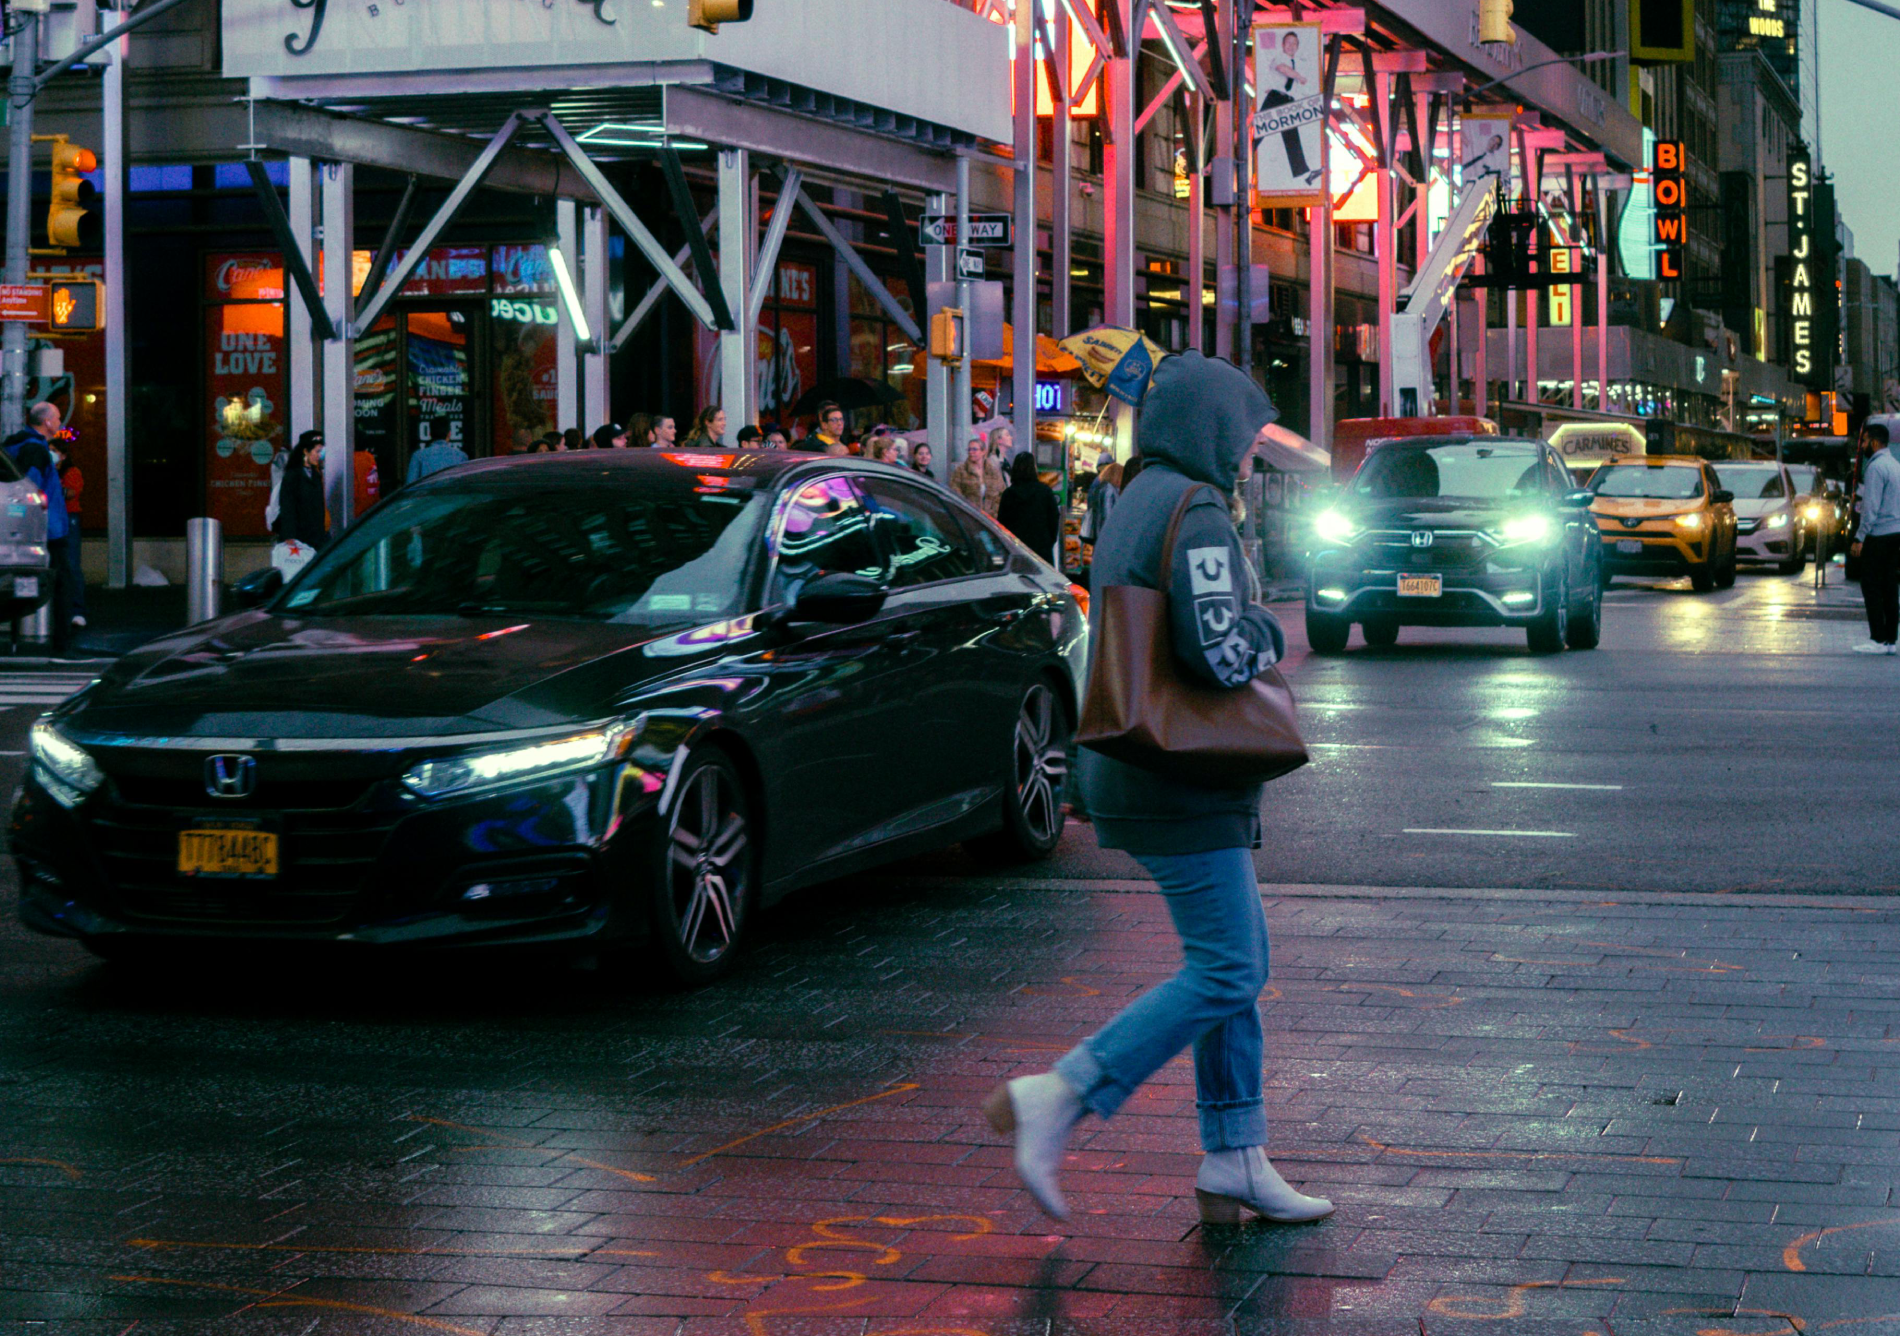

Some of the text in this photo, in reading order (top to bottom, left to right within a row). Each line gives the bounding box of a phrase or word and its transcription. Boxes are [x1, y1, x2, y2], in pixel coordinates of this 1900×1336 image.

[1749, 16, 1784, 38] WOODS
[1275, 99, 1305, 118] BOOK
[1255, 104, 1324, 135] MORMON
[1656, 143, 1679, 277] BOWL
[934, 224, 998, 236] ONE WAY
[12, 288, 43, 297] STANDING
[221, 330, 271, 351] ONE
[214, 351, 277, 375] LOVE
[419, 374, 463, 385] CHICKEN
[419, 385, 463, 396] FINGER
[419, 397, 464, 413] Meals
[419, 421, 463, 441] OE
